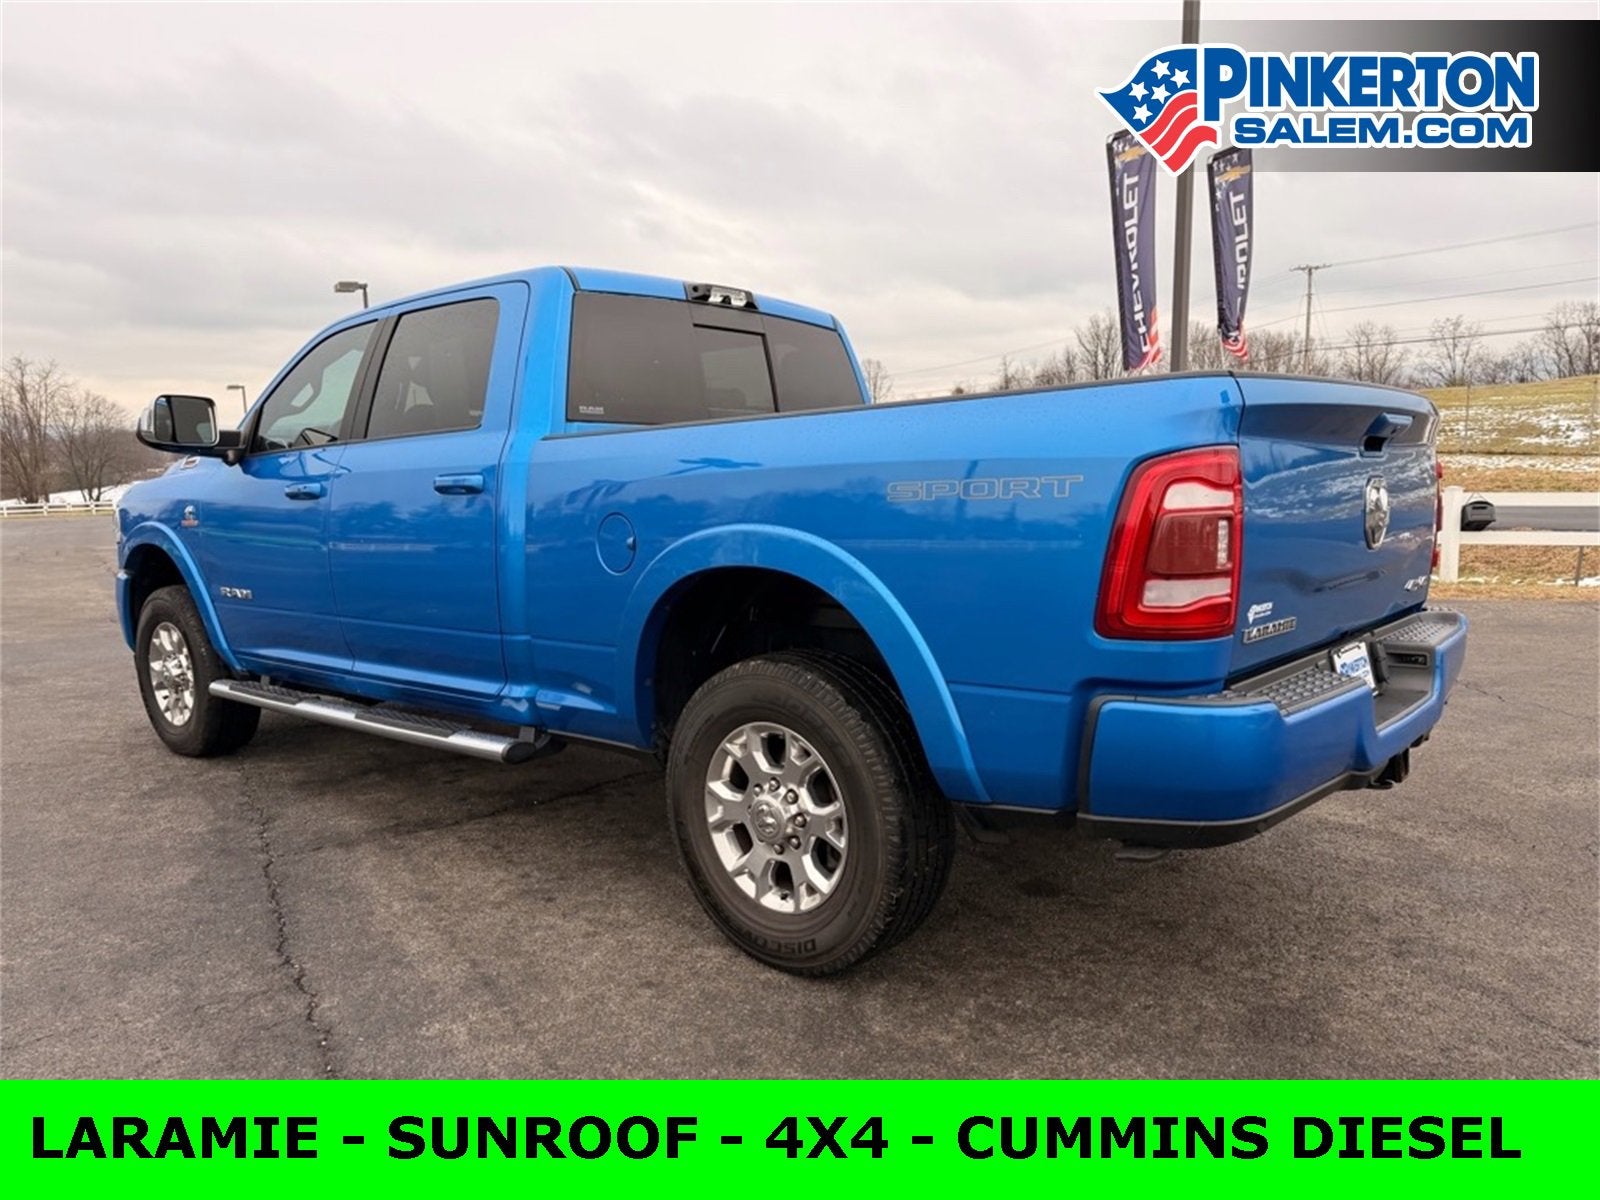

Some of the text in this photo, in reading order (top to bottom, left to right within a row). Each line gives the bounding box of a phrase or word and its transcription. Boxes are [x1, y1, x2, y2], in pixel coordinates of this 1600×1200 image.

[886, 474, 1084, 502] SPORT
[219, 586, 252, 600] RAM
[1242, 616, 1297, 644] LARAMIE
